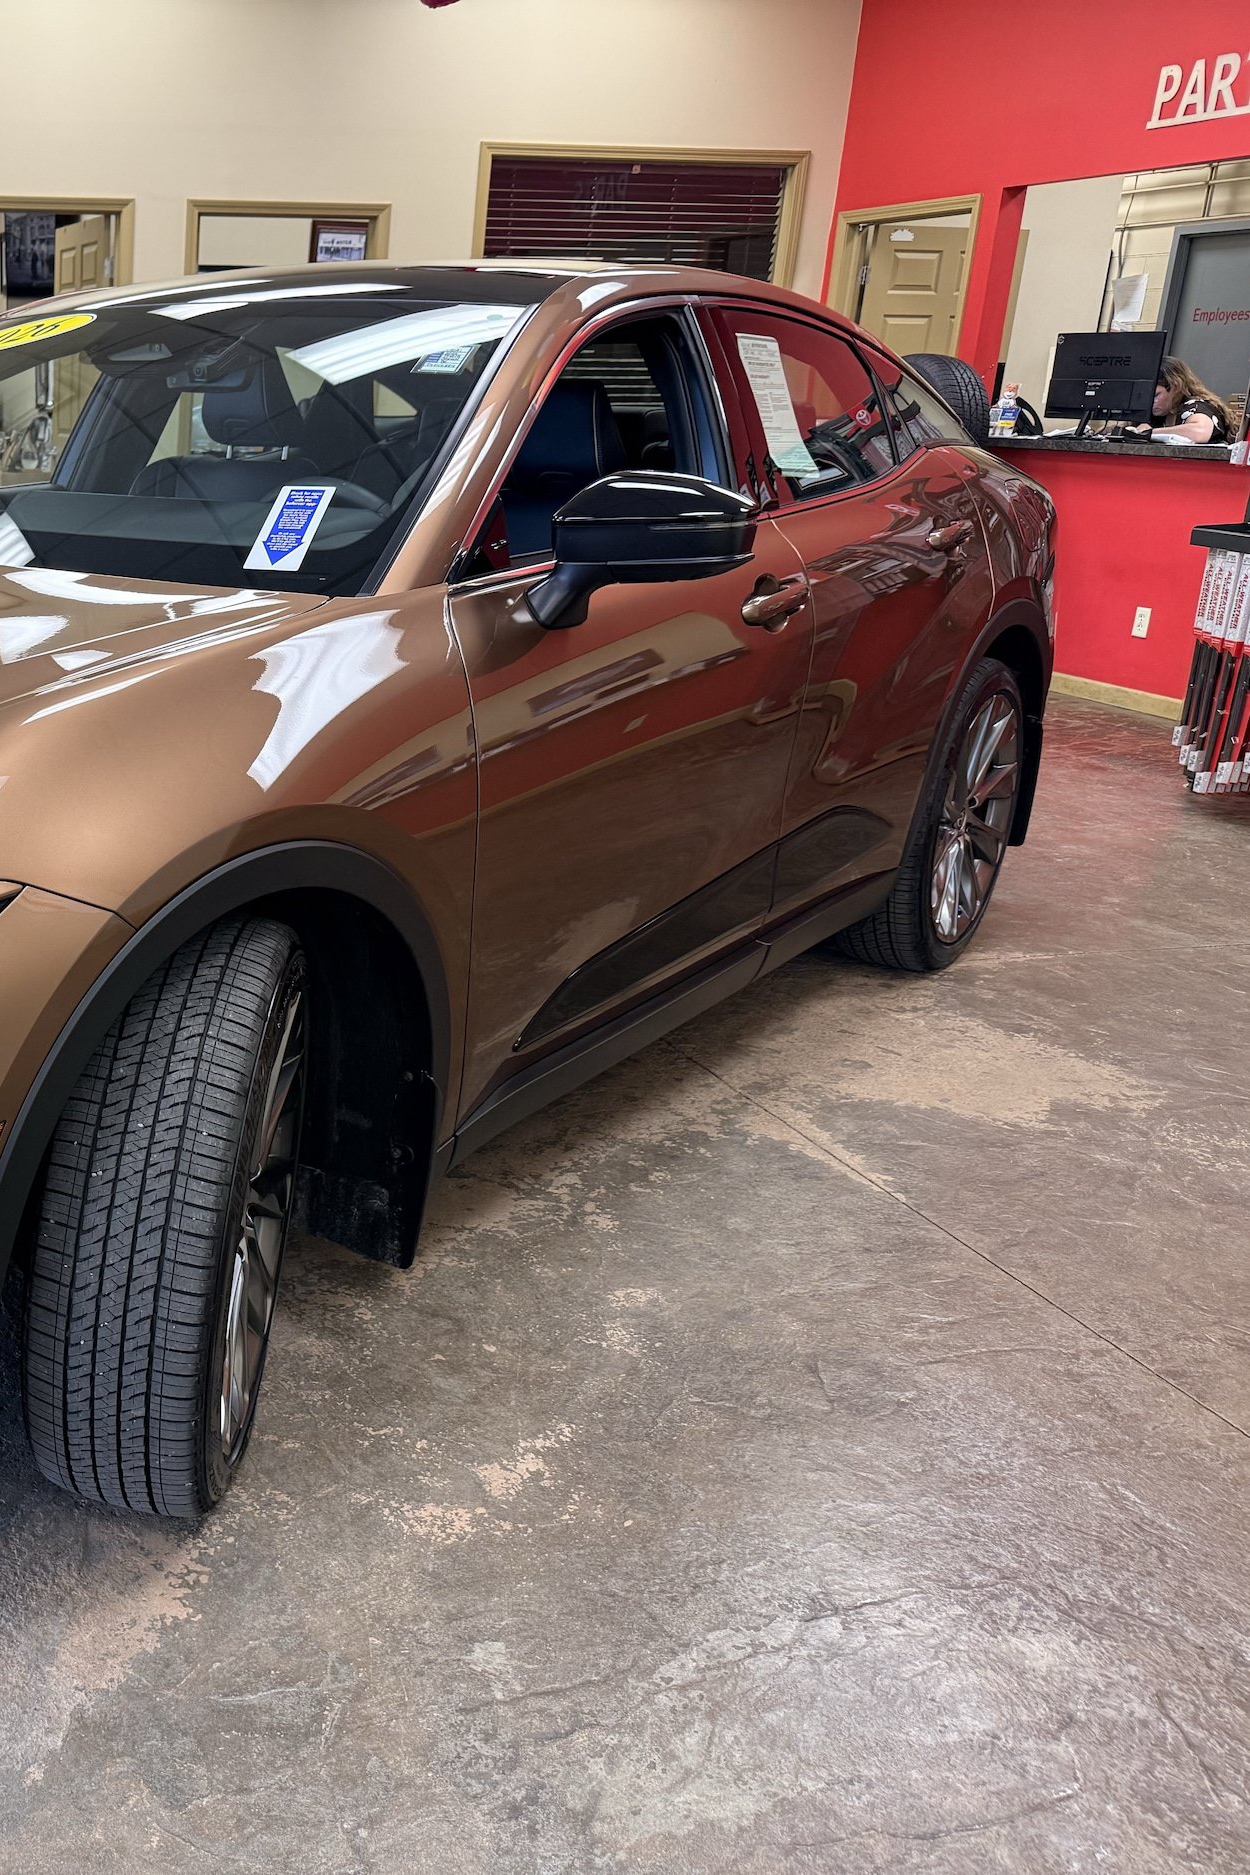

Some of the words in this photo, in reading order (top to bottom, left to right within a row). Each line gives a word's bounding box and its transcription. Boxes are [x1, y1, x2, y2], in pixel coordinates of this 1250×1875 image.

[1150, 51, 1250, 121] PAR
[1079, 356, 1132, 366] SCEPTRE
[1218, 570, 1233, 626] ALL-WEATHER
[1232, 573, 1249, 630] ALL-WEATHER
